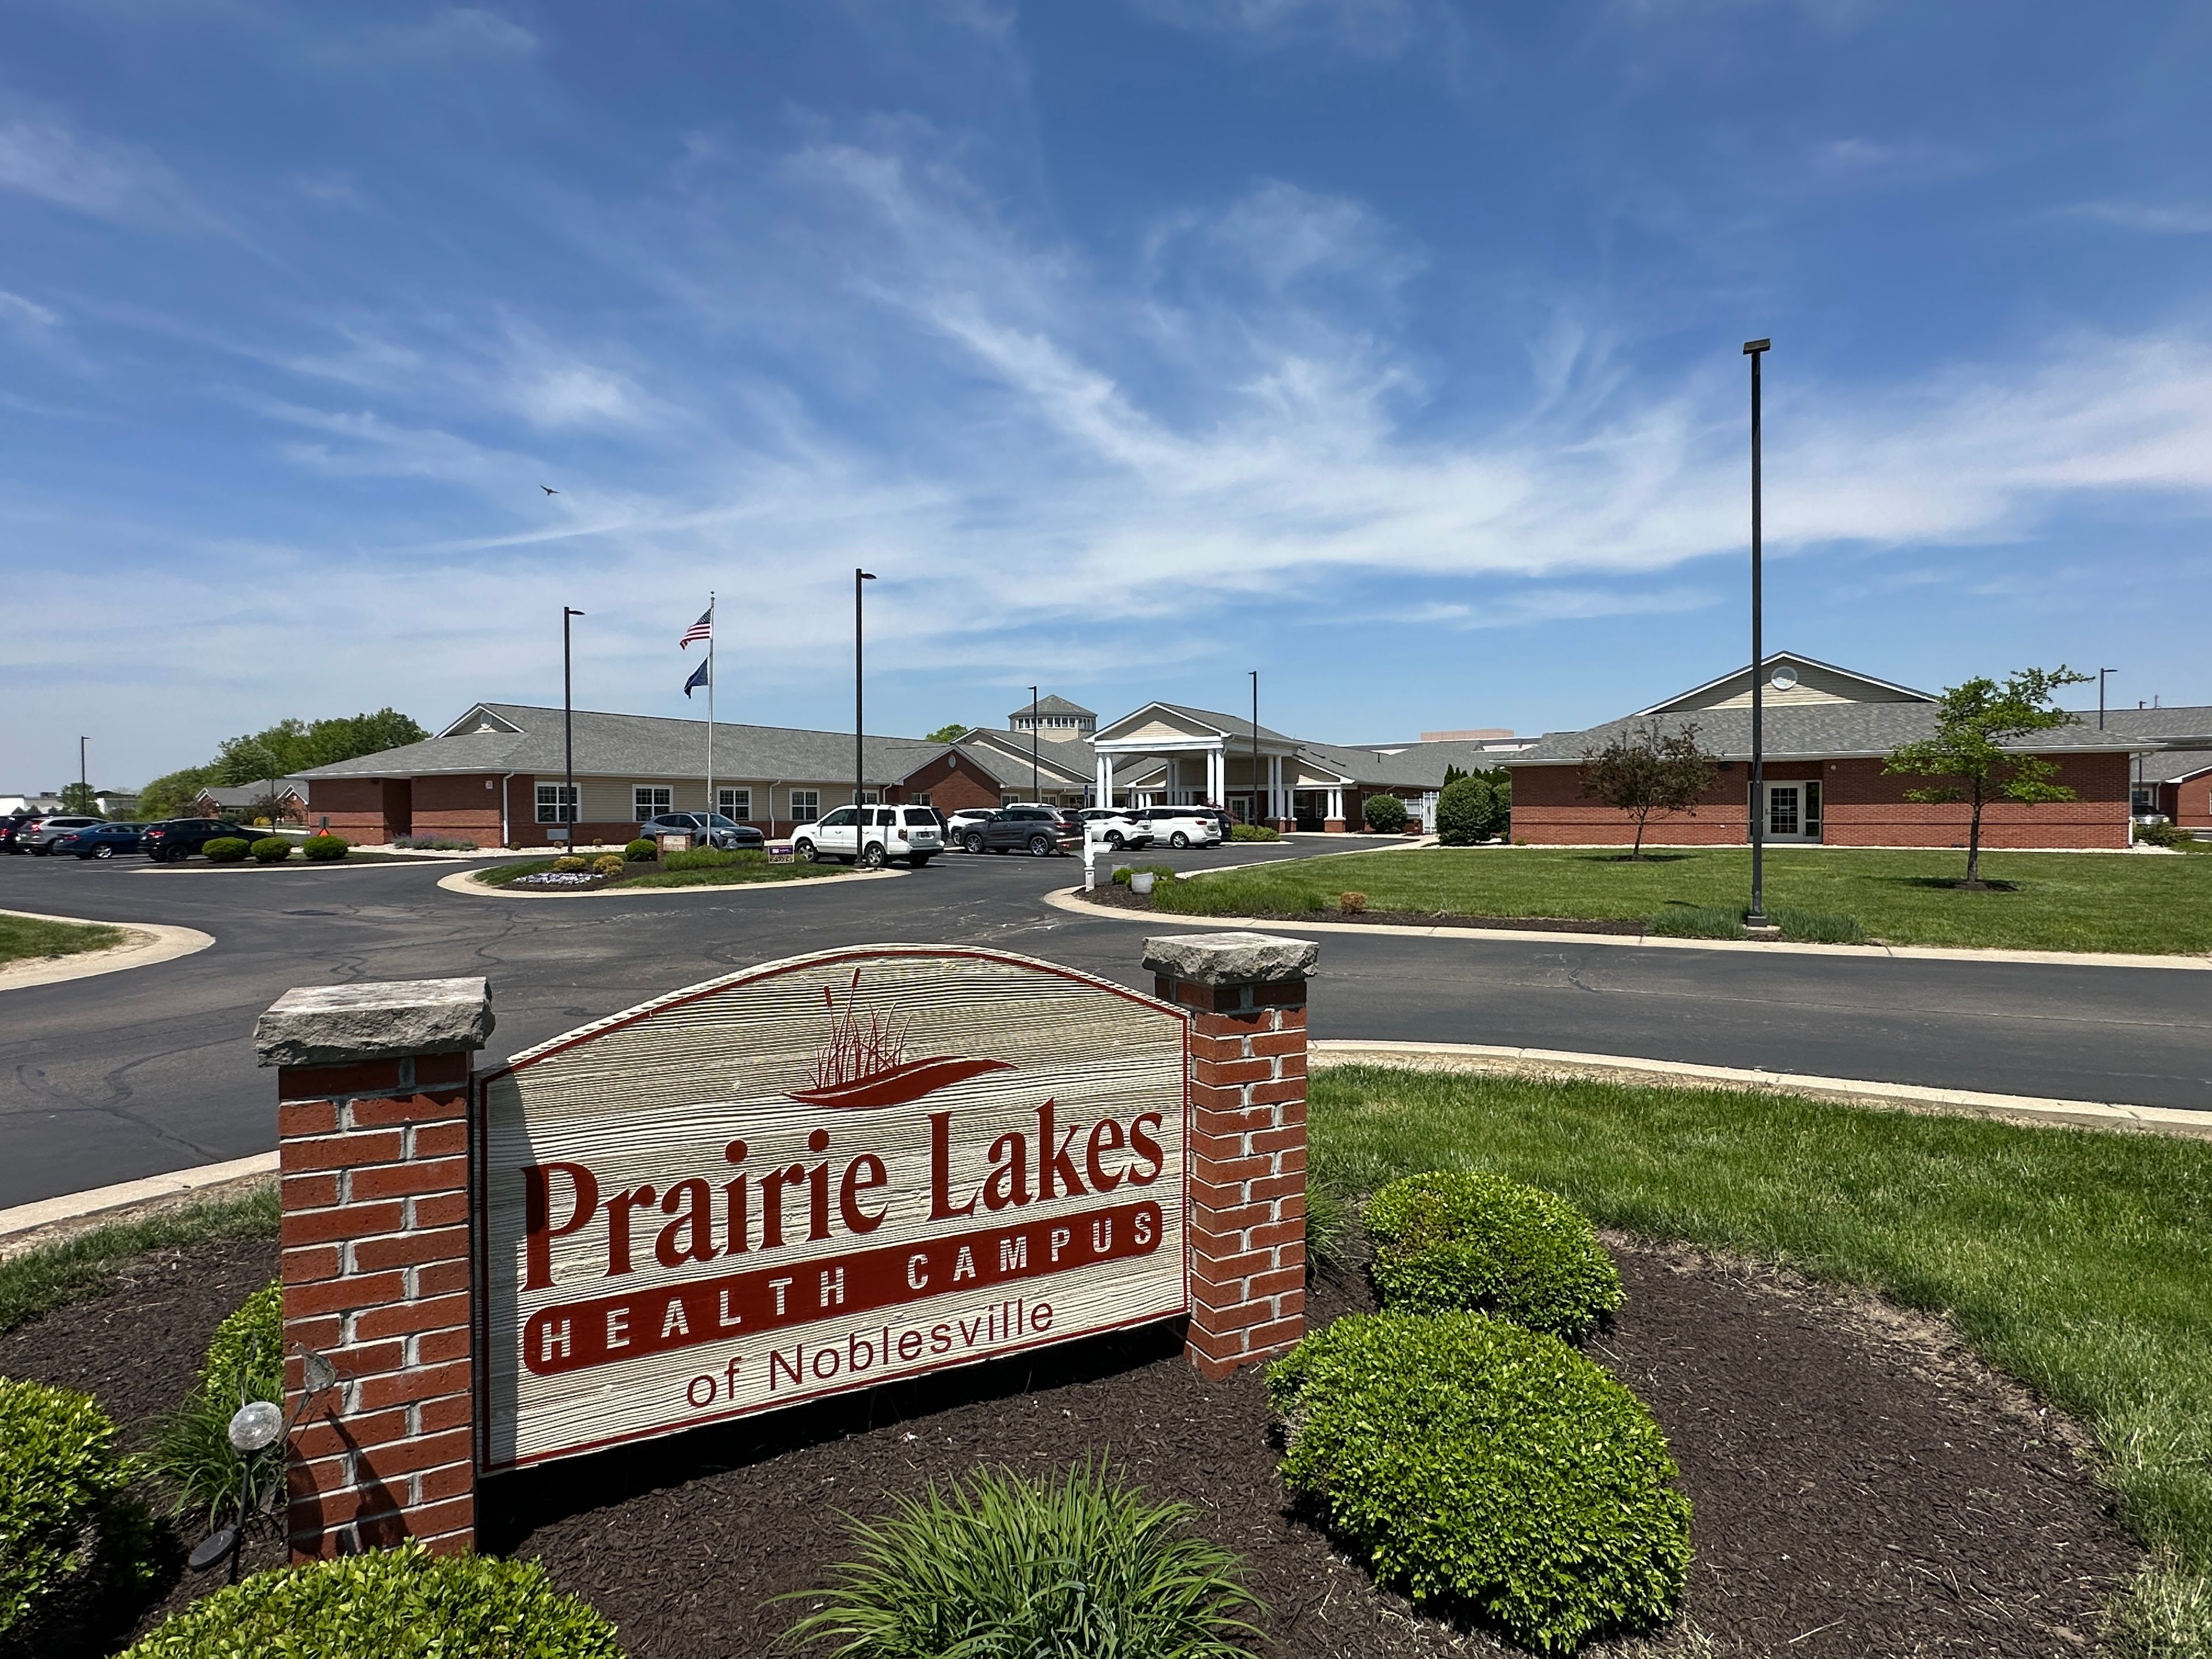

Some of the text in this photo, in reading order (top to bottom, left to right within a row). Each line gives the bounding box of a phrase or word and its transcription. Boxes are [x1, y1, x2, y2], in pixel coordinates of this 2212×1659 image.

[517, 1097, 1164, 1293] Prairie Lakes
[540, 1211, 1152, 1363] HEALTH CAMPUS
[686, 1298, 1054, 1408] of Noblesville
